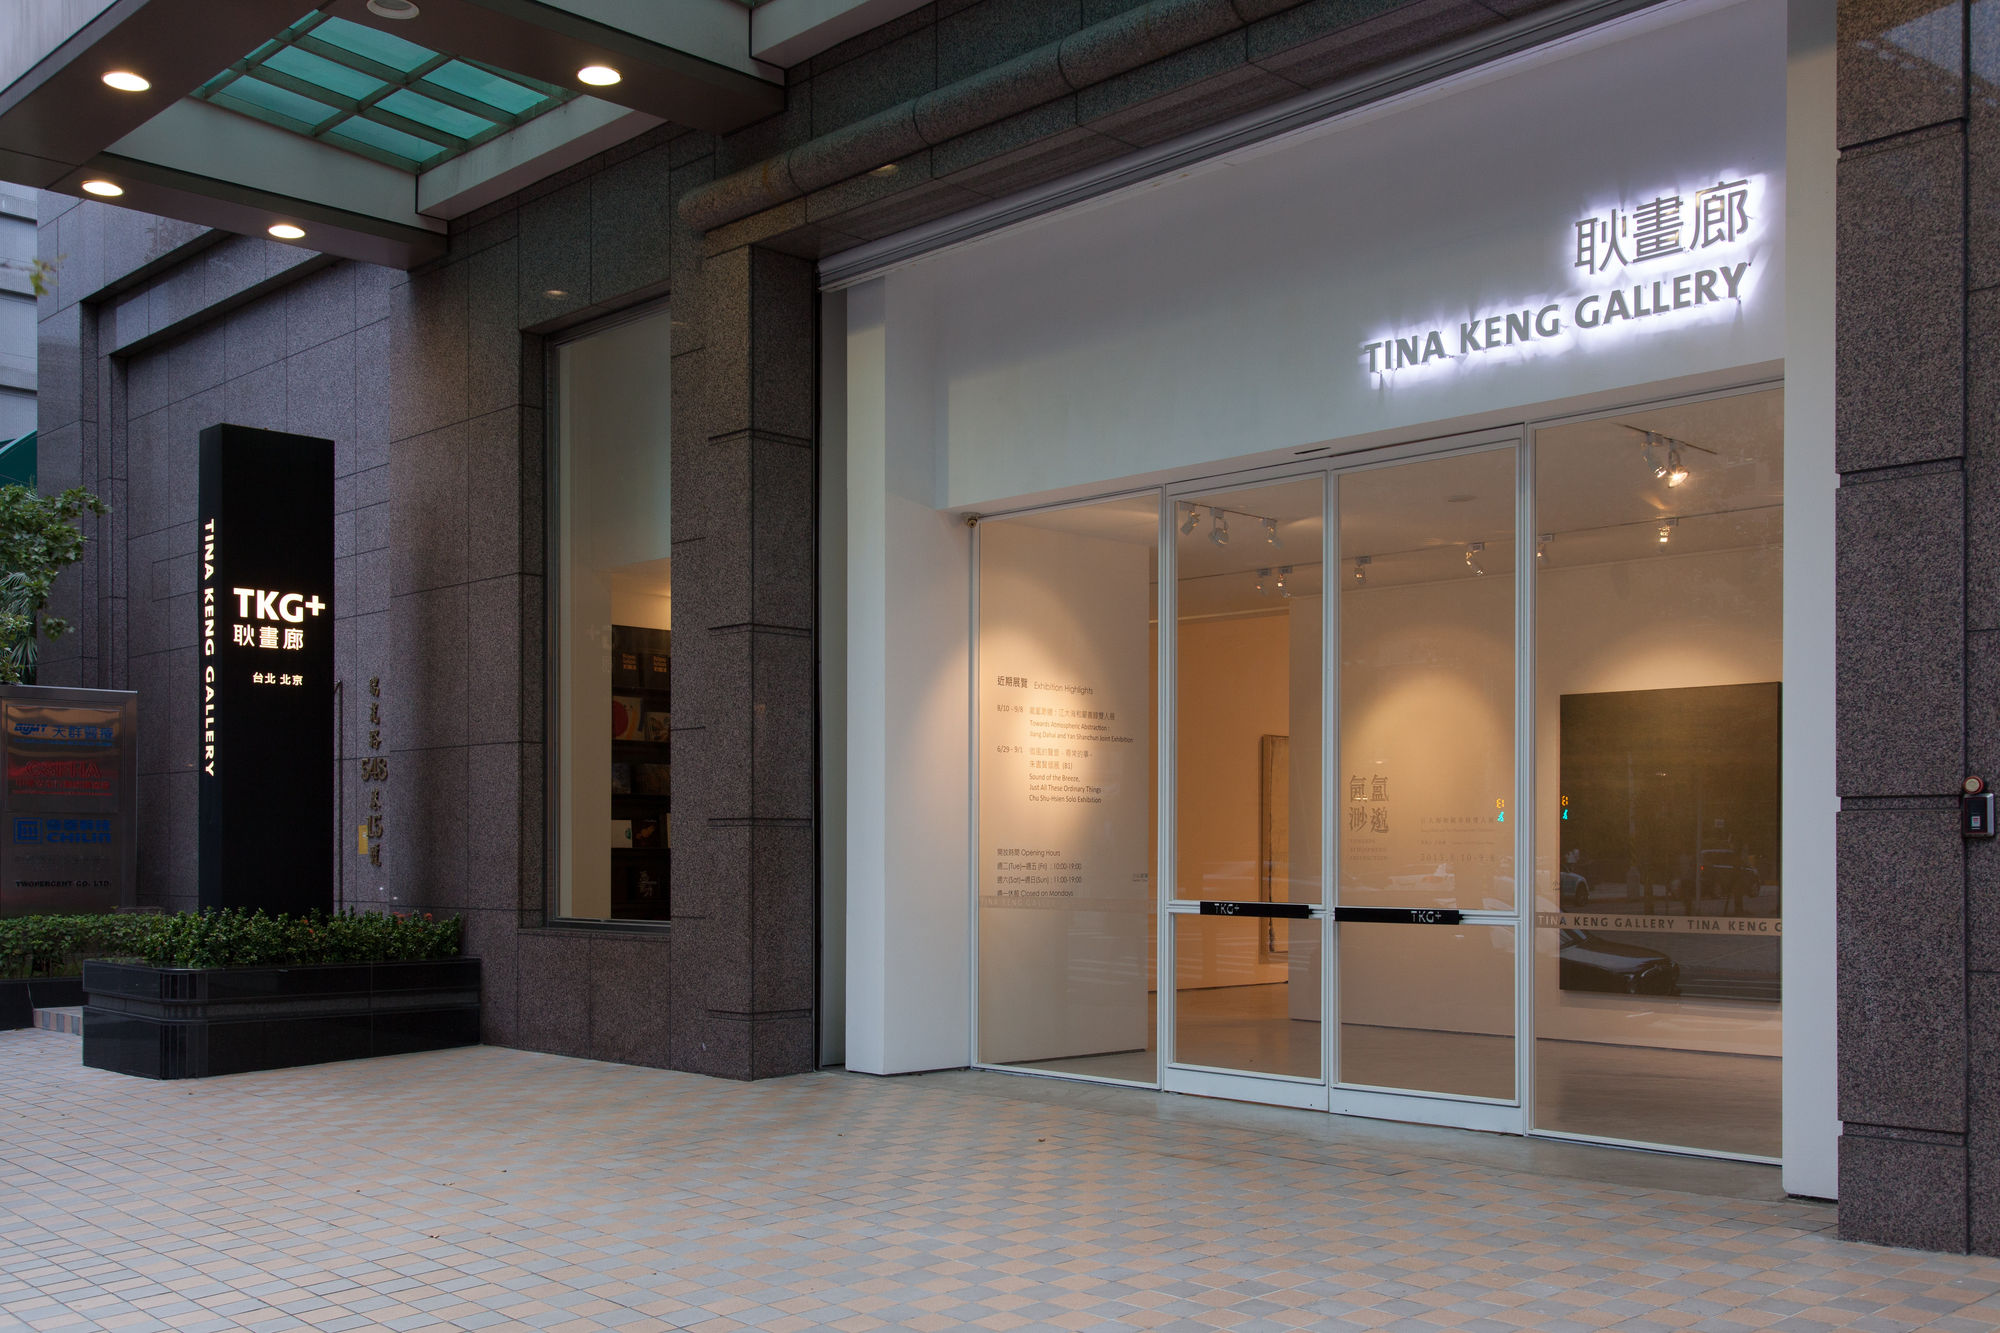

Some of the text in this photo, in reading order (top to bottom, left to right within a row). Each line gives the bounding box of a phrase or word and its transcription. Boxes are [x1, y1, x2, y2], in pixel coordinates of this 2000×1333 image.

[1574, 178, 1752, 275] 耿畫廊
[1364, 262, 1748, 373] TINA KENG GALLERY
[233, 587, 326, 623] TKG+
[233, 624, 304, 651] 耿畫廊
[204, 518, 215, 777] TINA KENG GALLERY
[252, 672, 304, 686] 台北 北京
[997, 675, 1028, 689] 近期展覽
[1033, 681, 1094, 695] Exhibition Highlights
[1021, 849, 1045, 857] Opening
[1045, 849, 1061, 857] Hours
[1214, 903, 1240, 915] TKG+
[1410, 910, 1442, 923] TKG+
[1537, 915, 1567, 927] TINA
[1573, 916, 1609, 927] KENG
[1614, 917, 1675, 929] GALLERY
[1687, 919, 1720, 931] TINA
[1728, 920, 1768, 932] KENG
